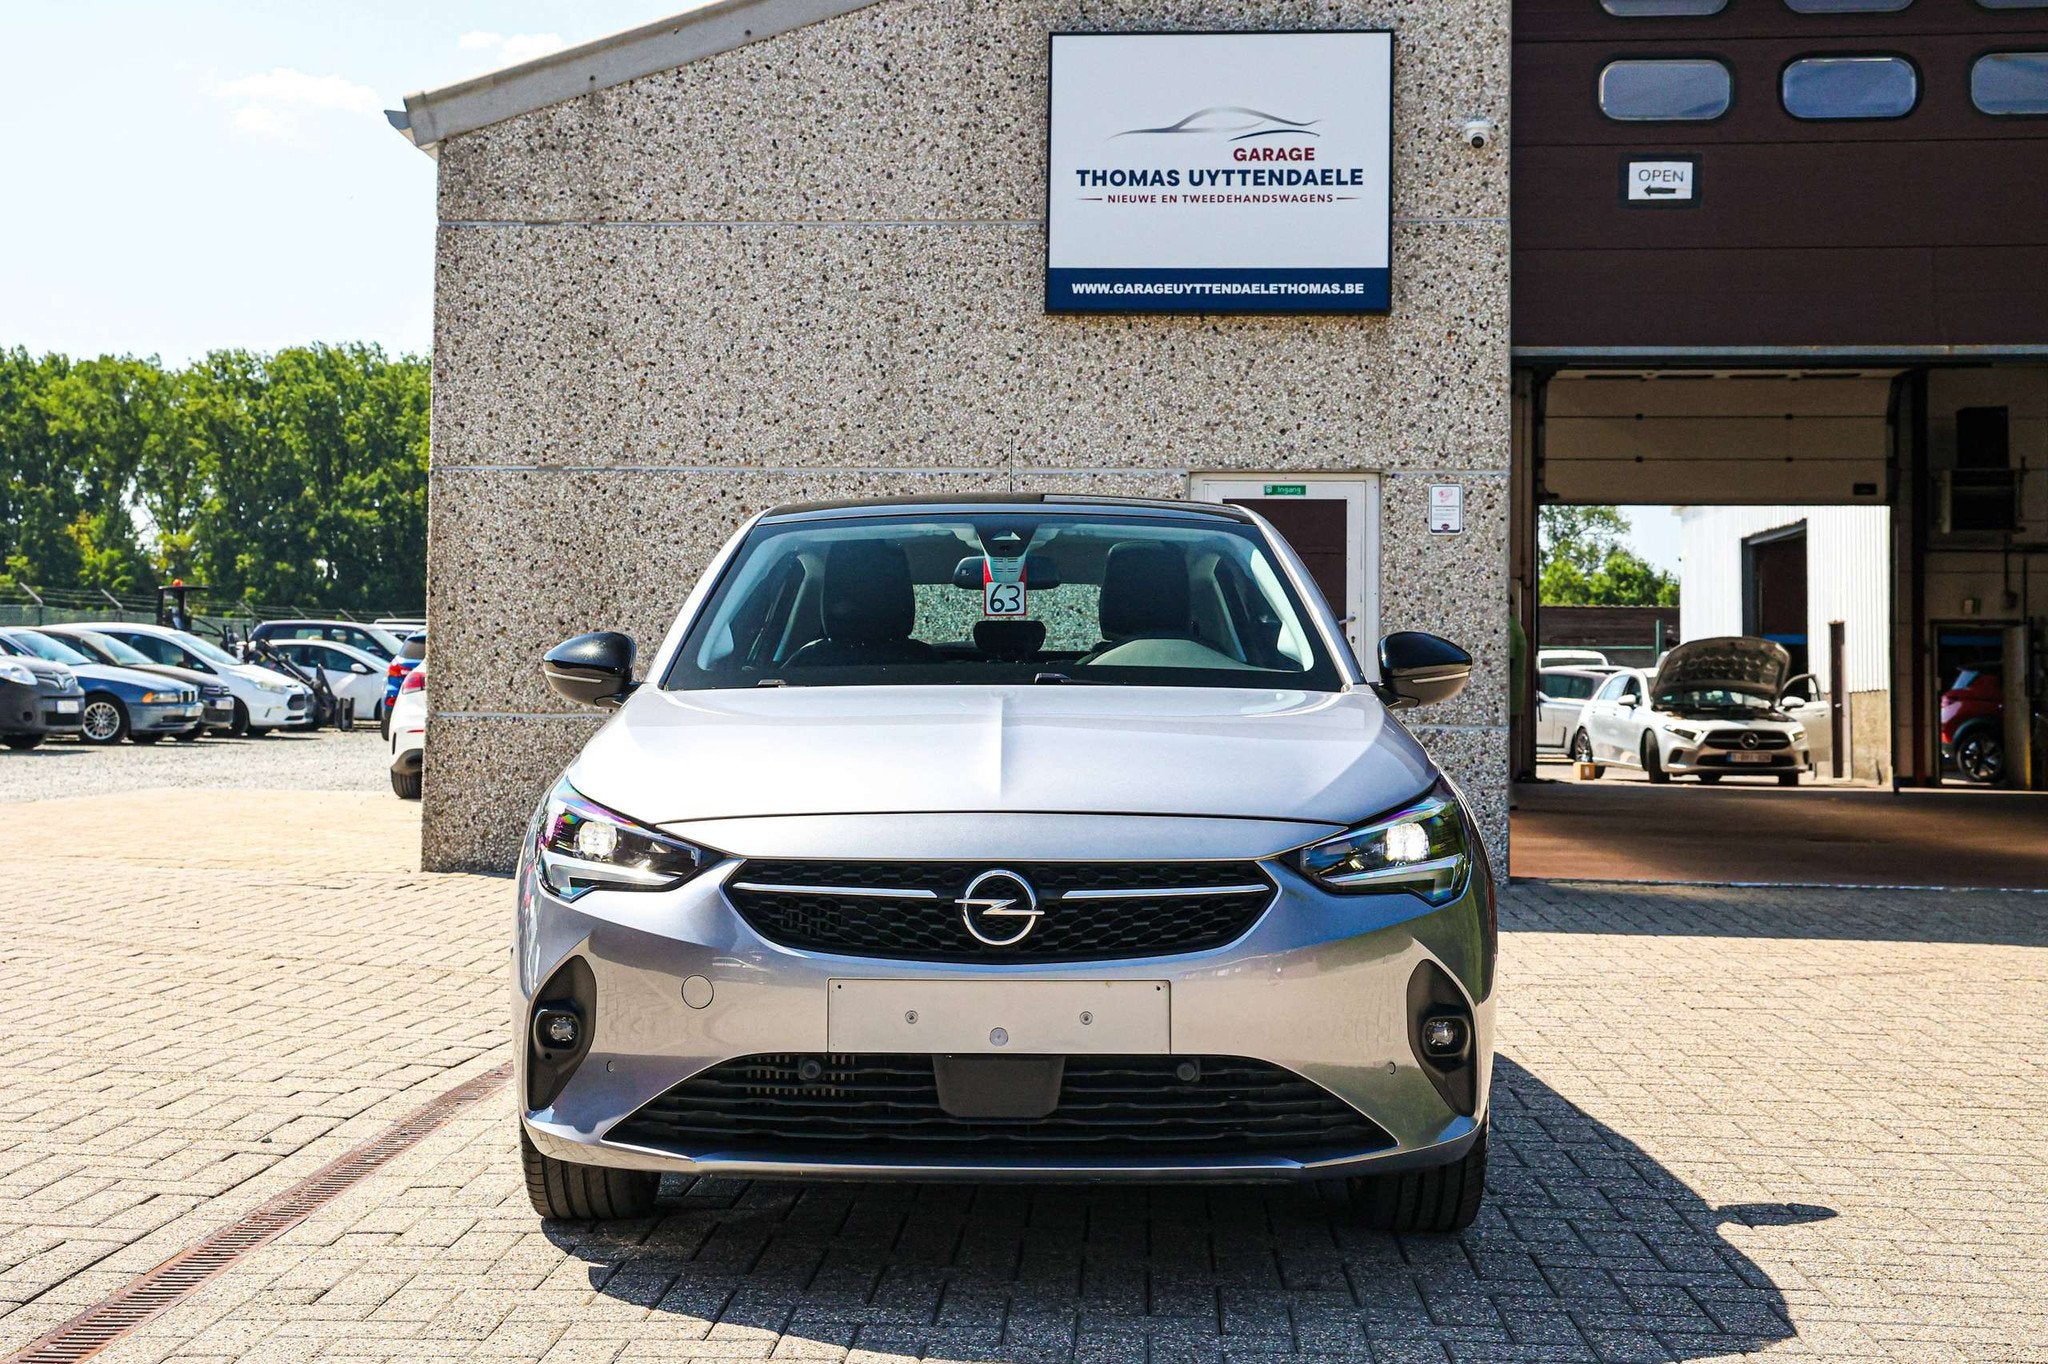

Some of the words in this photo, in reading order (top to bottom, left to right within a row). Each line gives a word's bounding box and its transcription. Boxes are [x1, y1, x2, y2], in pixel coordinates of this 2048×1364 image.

[1233, 147, 1315, 161] GARAGE
[1076, 169, 1181, 187] THOMAS
[1188, 168, 1364, 187] UYTTENDAELE
[1638, 169, 1684, 182] OPEN
[1107, 194, 1157, 203] NIEUWE
[1161, 194, 1178, 203] EN
[1182, 193, 1334, 203] TWEEDEHANDSWAGENS
[1072, 283, 1365, 295] WWW.GARAGEUYTTENDAELETHOMAS.BE
[1277, 486, 1301, 495] Ingang
[989, 584, 1021, 613] 63
